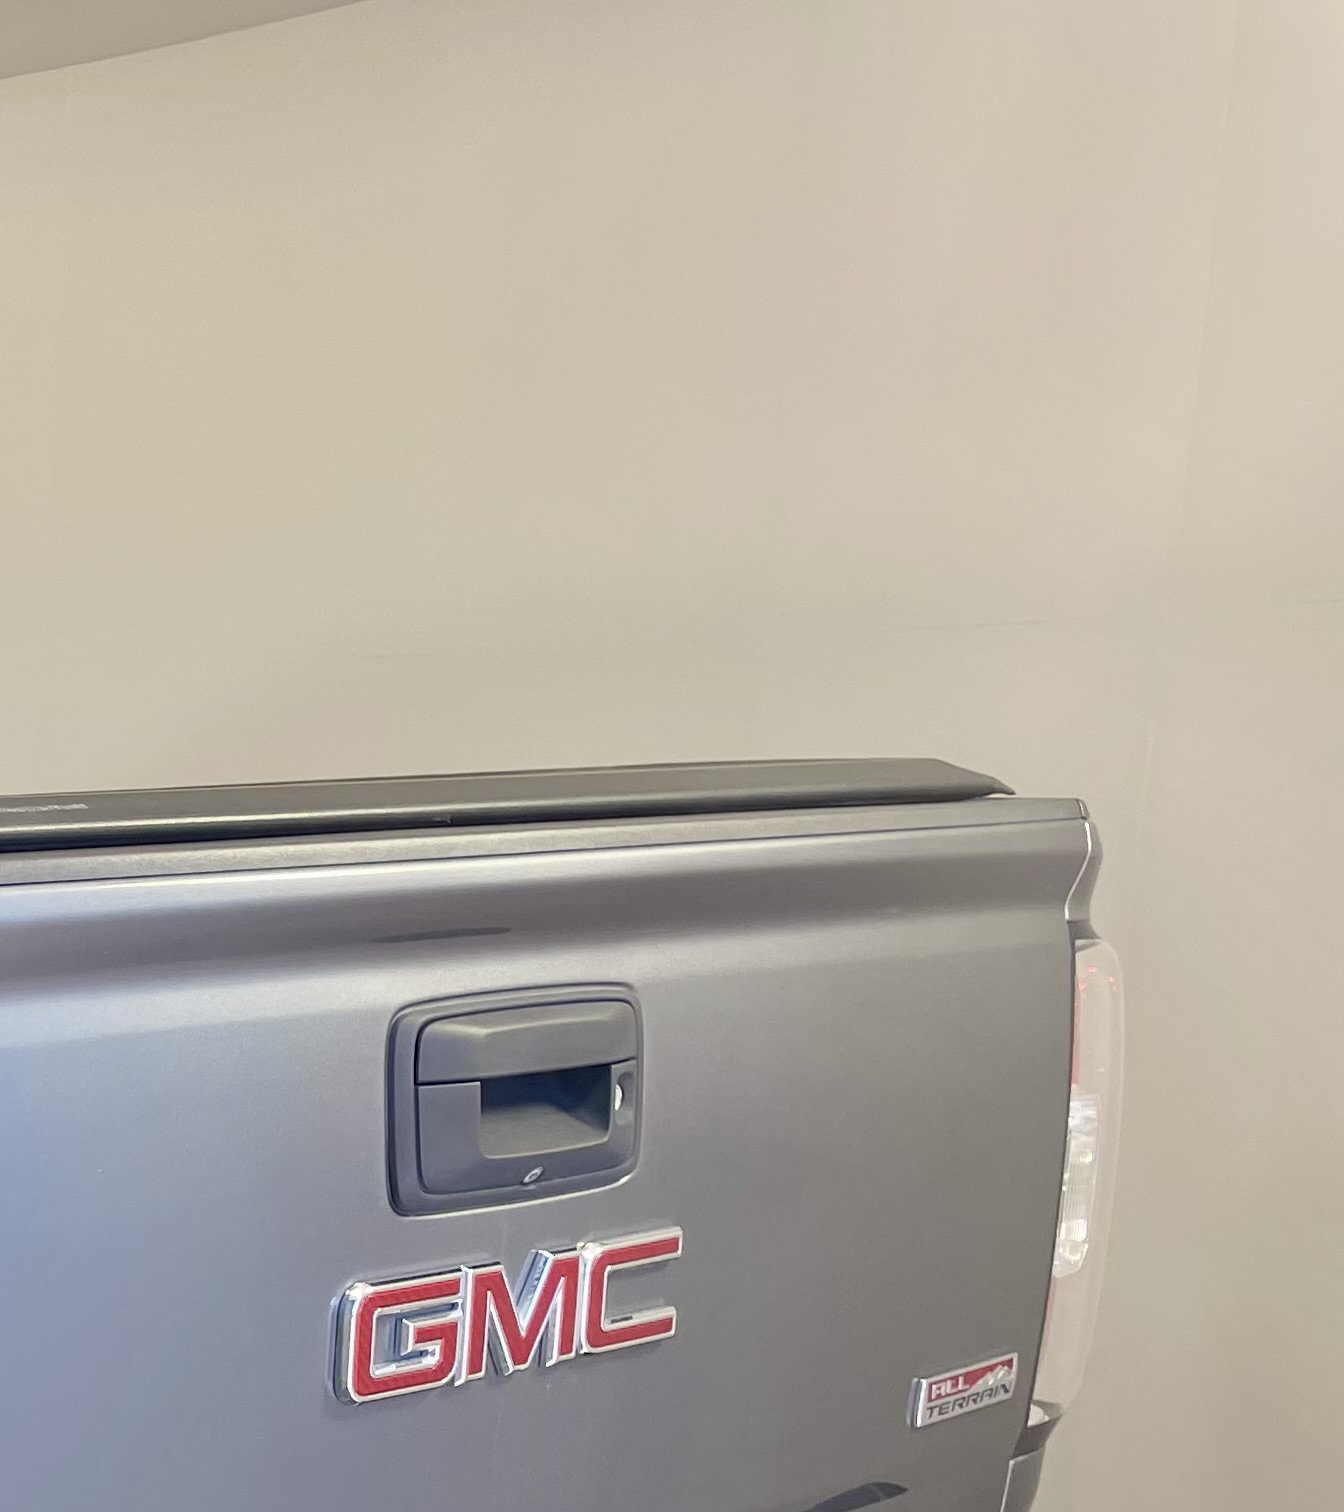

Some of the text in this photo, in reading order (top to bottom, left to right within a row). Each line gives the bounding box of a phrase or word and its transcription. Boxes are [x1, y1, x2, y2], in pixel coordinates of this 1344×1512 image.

[332, 1226, 683, 1405] GMC
[927, 1383, 1012, 1419] TERRAIN
[930, 1376, 970, 1400] ALL
